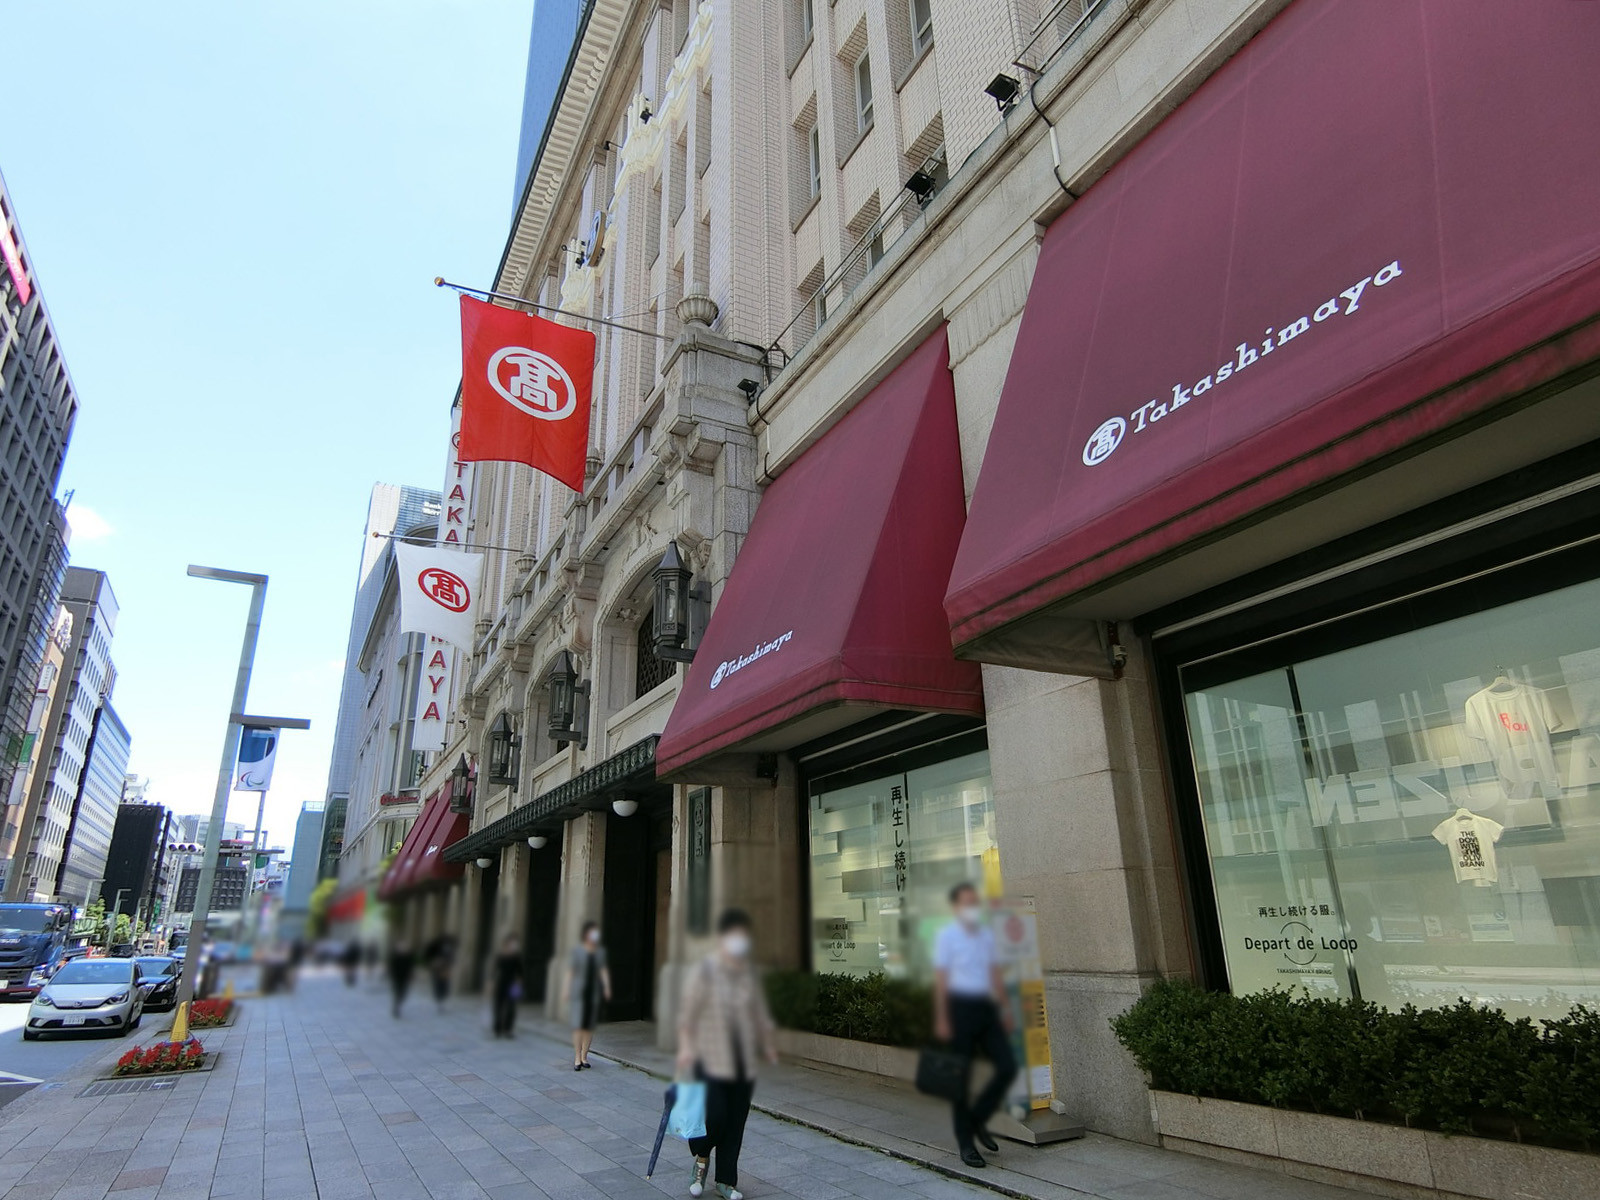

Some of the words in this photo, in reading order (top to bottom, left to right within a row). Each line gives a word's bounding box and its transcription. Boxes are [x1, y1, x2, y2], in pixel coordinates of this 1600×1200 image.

[1130, 260, 1402, 433] Takashimaya
[725, 630, 793, 677] Takashimaya
[891, 785, 906, 906] 再生し続け
[1258, 904, 1335, 918] 再生し続ける服。
[1244, 937, 1291, 953] Depart
[1297, 936, 1314, 950] de
[1320, 936, 1358, 953] Loop
